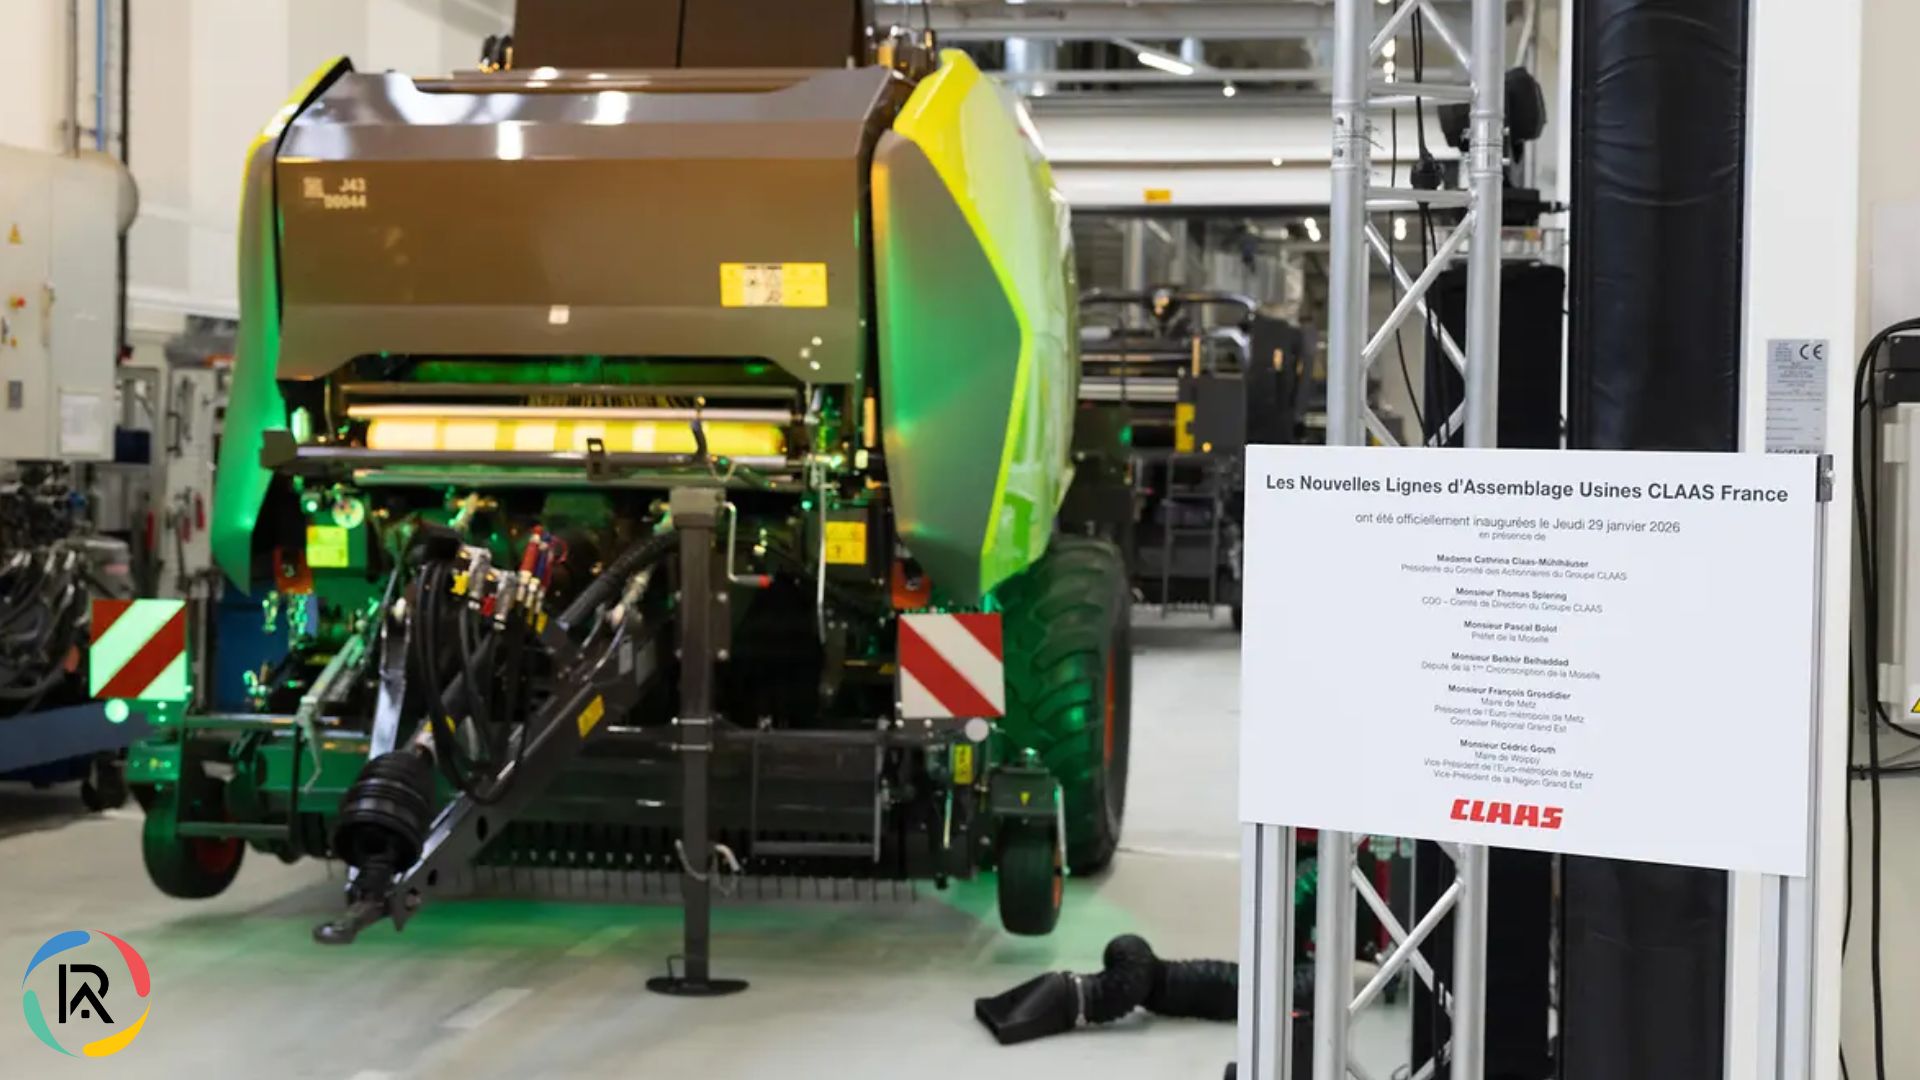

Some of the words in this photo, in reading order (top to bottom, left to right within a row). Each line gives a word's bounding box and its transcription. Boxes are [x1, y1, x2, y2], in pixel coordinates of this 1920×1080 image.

[1267, 475, 1295, 489] Les
[1300, 475, 1380, 492] Nouvelles
[1386, 477, 1442, 496] Lignes
[1448, 479, 1573, 500] d'Assemblage
[1580, 482, 1642, 499] Usines
[1648, 483, 1714, 500] CLAAS
[1722, 485, 1788, 502] France
[1355, 513, 1372, 524] ont
[1377, 514, 1392, 524] été
[1397, 515, 1469, 526] officiellement
[1474, 516, 1535, 530] inaugurées
[1540, 518, 1548, 529] le
[1553, 519, 1584, 530] Jeudi
[1589, 520, 1602, 531] 29
[1607, 521, 1645, 533] janvier
[1650, 522, 1681, 533] 2026
[1492, 532, 1531, 541] présence
[1534, 532, 1546, 540] de
[1436, 554, 1472, 563] Madame
[1401, 564, 1441, 573] Présidente
[1443, 565, 1453, 574] du
[1455, 566, 1483, 575] Comité
[1485, 567, 1499, 575] des
[1501, 568, 1549, 578] Actionnaires
[1552, 570, 1562, 578] du
[1565, 570, 1595, 581] Groupe
[1597, 571, 1628, 581] CLAAS
[1456, 587, 1494, 596] Monsieur
[1496, 588, 1529, 597] Thomas
[1450, 598, 1477, 608] Comité
[1480, 600, 1489, 608] de
[1492, 600, 1526, 610] Direction
[1529, 602, 1539, 610] du
[1542, 602, 1571, 613] Groupe
[1574, 604, 1602, 613] CLAAS
[1464, 620, 1502, 630] Monsieur
[1504, 622, 1532, 631] Pascal
[1535, 624, 1557, 633] Bolot
[1472, 631, 1494, 641] Préfet
[1497, 633, 1507, 641] de
[1509, 633, 1515, 642] la
[1518, 634, 1549, 643] Moselle
[1452, 652, 1489, 662] Monsieur
[1492, 654, 1521, 664] Belkhir
[1451, 663, 1460, 672] de
[1462, 664, 1470, 672] la
[1547, 668, 1557, 677] de
[1560, 669, 1566, 678] la
[1569, 670, 1600, 680] Moselle
[1448, 684, 1486, 694] Monsieur
[1488, 686, 1524, 697] François
[1527, 689, 1571, 700] Grosdidier
[1481, 697, 1502, 706] Maire
[1504, 699, 1514, 707] de
[1517, 700, 1536, 709] Metz
[1434, 704, 1470, 715] Président
[1473, 707, 1482, 716] de
[1552, 712, 1562, 721] de
[1565, 713, 1585, 723] Metz
[1450, 717, 1488, 728] Conseiller
[1491, 720, 1524, 731] Régional
[1527, 722, 1551, 732] Grand
[1554, 724, 1567, 733] Est
[1460, 739, 1498, 750] Monsieur
[1501, 742, 1527, 752] Cédric
[1530, 744, 1556, 754] Gouth
[1475, 751, 1496, 760] Maire
[1499, 753, 1508, 761] de
[1424, 758, 1479, 771] Vice-Président
[1482, 762, 1491, 771] de
[1561, 768, 1571, 778] de
[1573, 769, 1594, 779] Metz
[1433, 769, 1488, 782] Vice-Président
[1491, 774, 1501, 783] de
[1503, 775, 1510, 784] la
[1513, 776, 1539, 787] Région
[1542, 778, 1567, 788] Grand
[1570, 780, 1582, 790] Est
[1450, 798, 1563, 829] CLAAS
